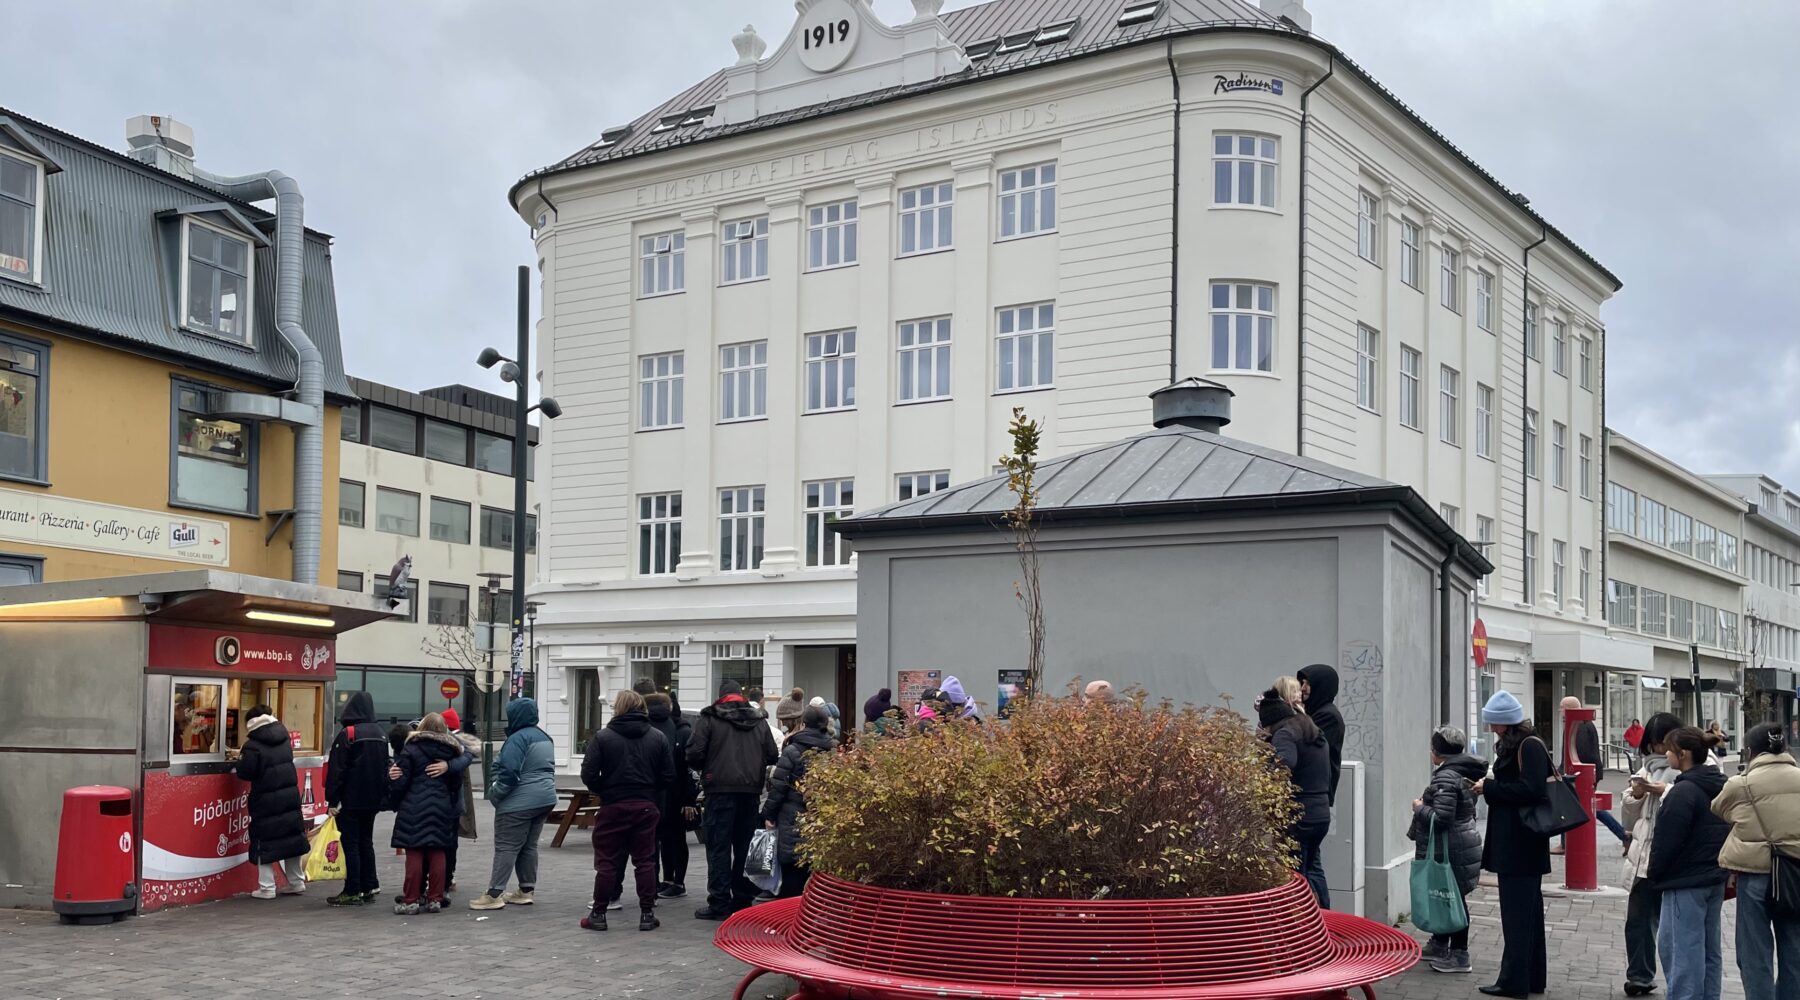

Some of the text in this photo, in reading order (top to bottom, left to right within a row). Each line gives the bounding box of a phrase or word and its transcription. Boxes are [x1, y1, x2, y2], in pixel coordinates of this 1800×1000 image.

[804, 19, 850, 50] 1919
[1214, 71, 1272, 95] Radisson
[915, 103, 1060, 152] ISLANDS
[40, 512, 84, 530] Pizzeria
[93, 519, 129, 541] Gallery
[137, 525, 160, 544] Café
[173, 529, 196, 541] Gull
[243, 650, 293, 663] www.bbp.is
[194, 790, 249, 827] Þjóðarré
[228, 812, 252, 835] Ísle
